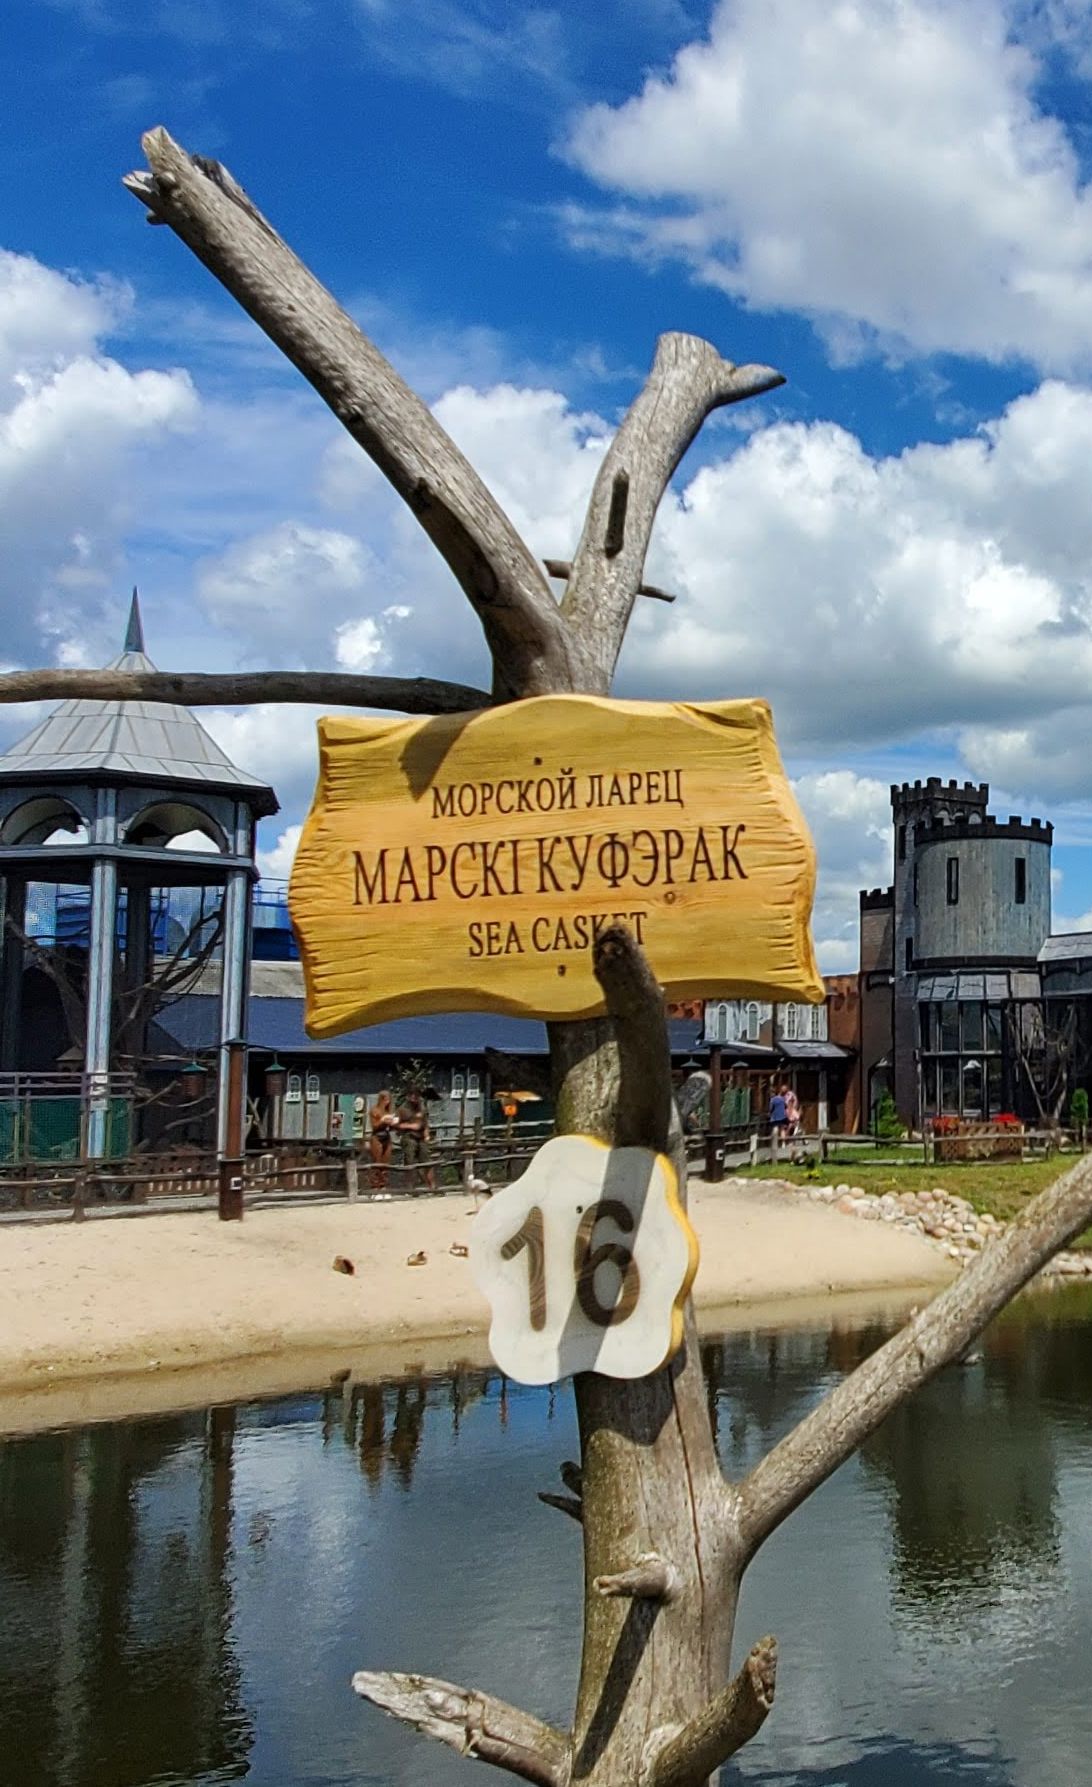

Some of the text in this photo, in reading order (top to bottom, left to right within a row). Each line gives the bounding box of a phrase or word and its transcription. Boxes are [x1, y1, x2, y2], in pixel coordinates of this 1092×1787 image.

[431, 767, 685, 819] МОРСКОЙ ЛАРЕЦ
[352, 824, 749, 905] МАРСКІ КУФЭРАК
[468, 911, 648, 957] SEA CASKT
[500, 1200, 641, 1332] 16
